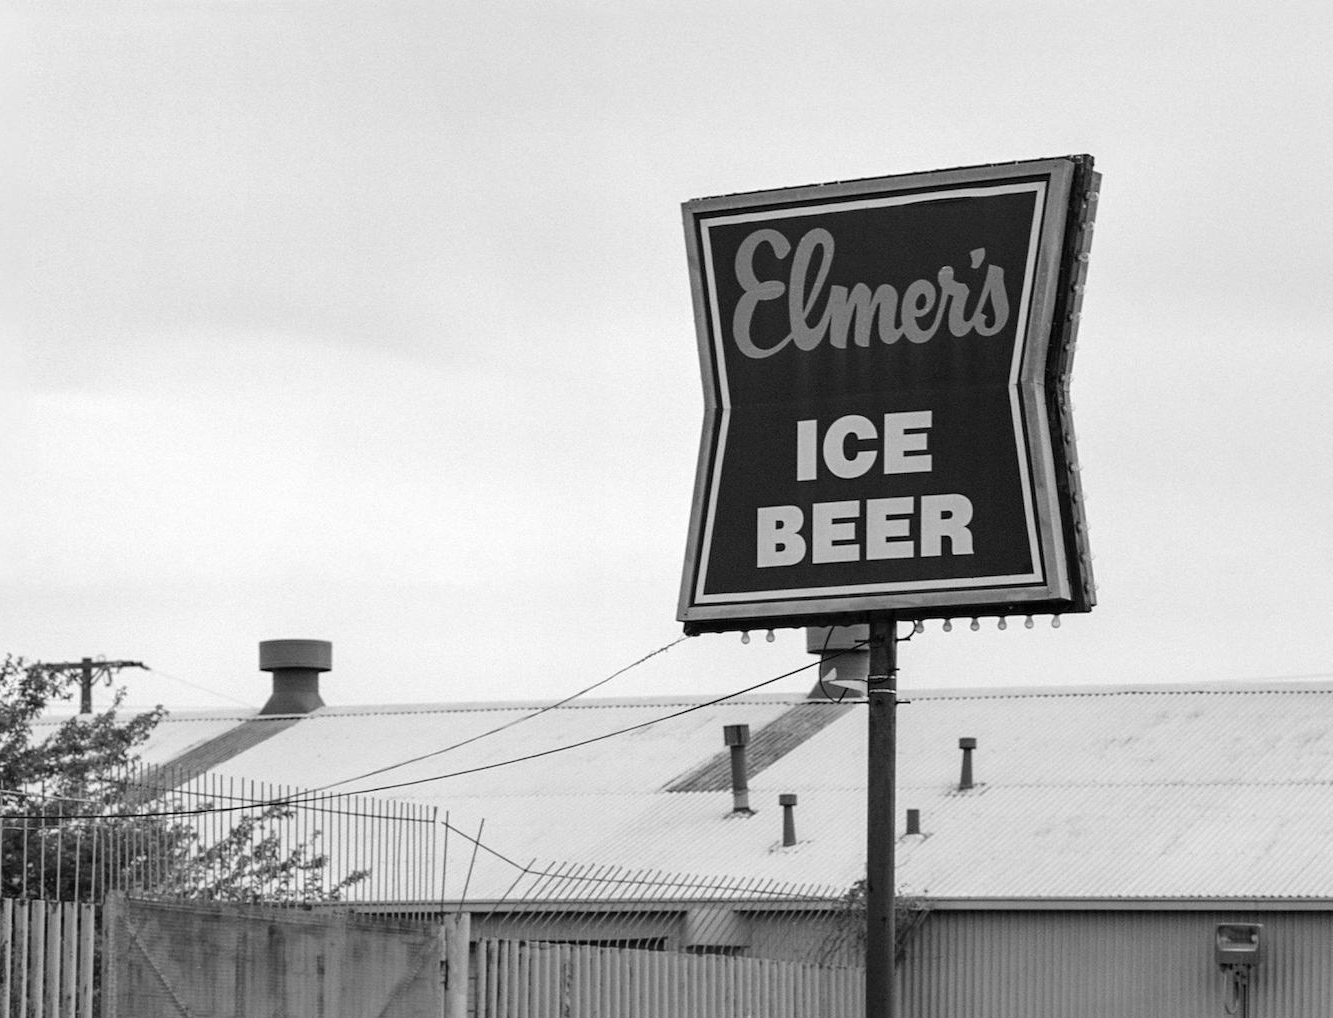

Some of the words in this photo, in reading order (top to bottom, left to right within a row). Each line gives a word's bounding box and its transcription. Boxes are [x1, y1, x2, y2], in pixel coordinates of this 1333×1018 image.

[733, 227, 1010, 359] Elmer's
[796, 410, 933, 482] ICE
[756, 493, 975, 568] BEER
